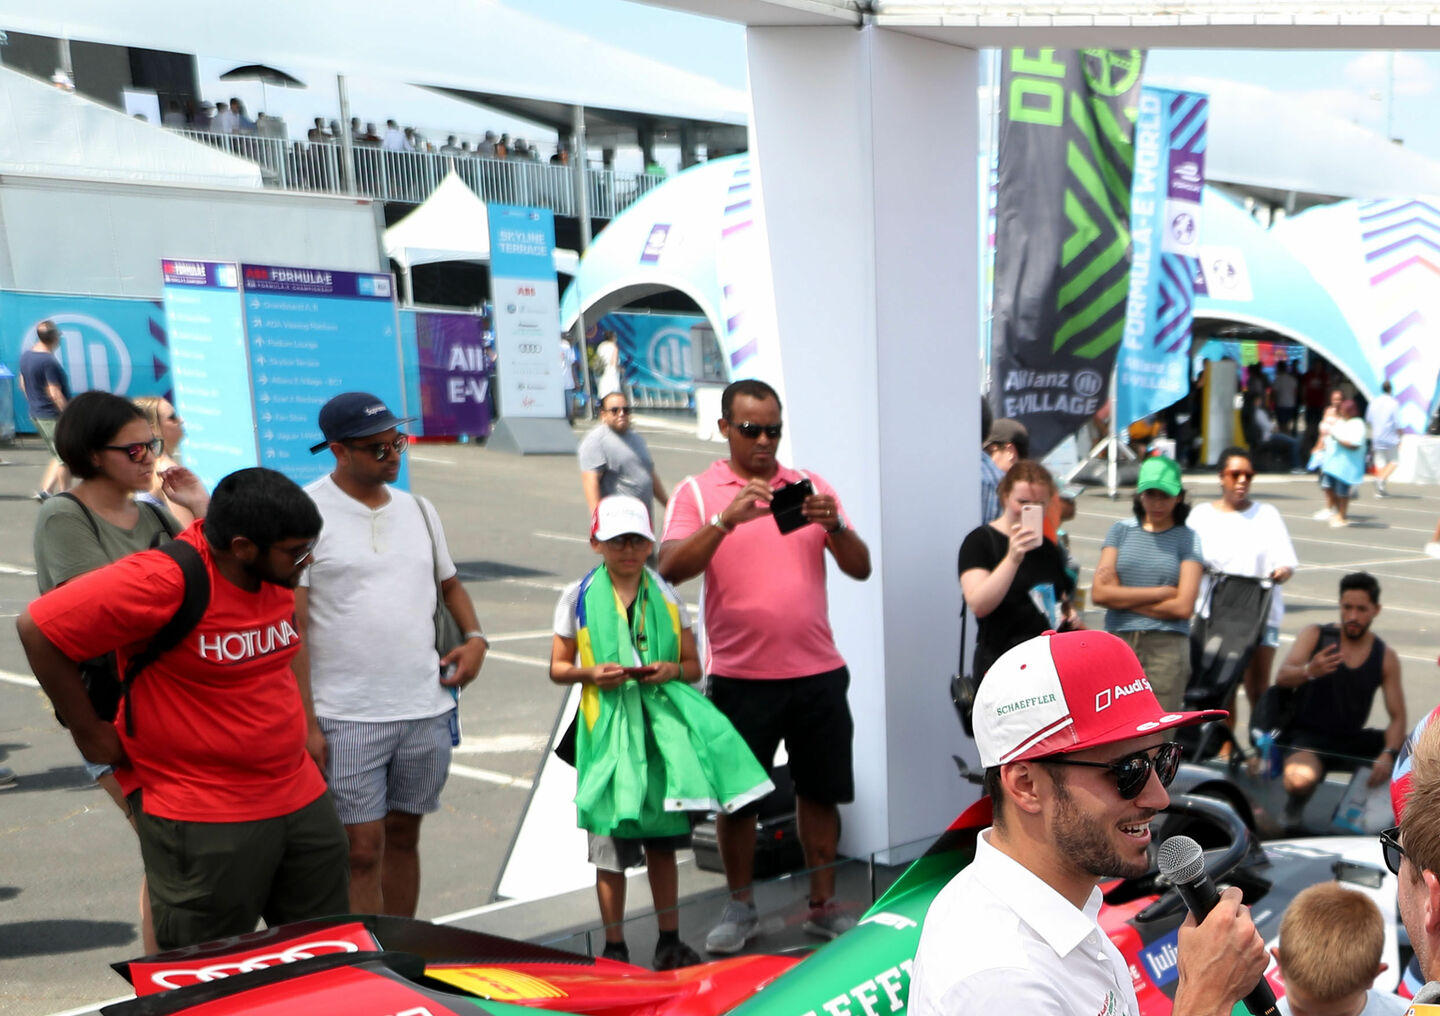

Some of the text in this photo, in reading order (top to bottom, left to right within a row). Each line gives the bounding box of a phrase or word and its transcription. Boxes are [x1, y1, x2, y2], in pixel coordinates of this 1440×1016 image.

[1136, 95, 1162, 194] WORLD
[1004, 370, 1070, 392] Allianz
[1004, 394, 1099, 418] E-VILLAGE
[1114, 678, 1143, 700] Audi
[996, 693, 1058, 717] SCHAEFFLER
